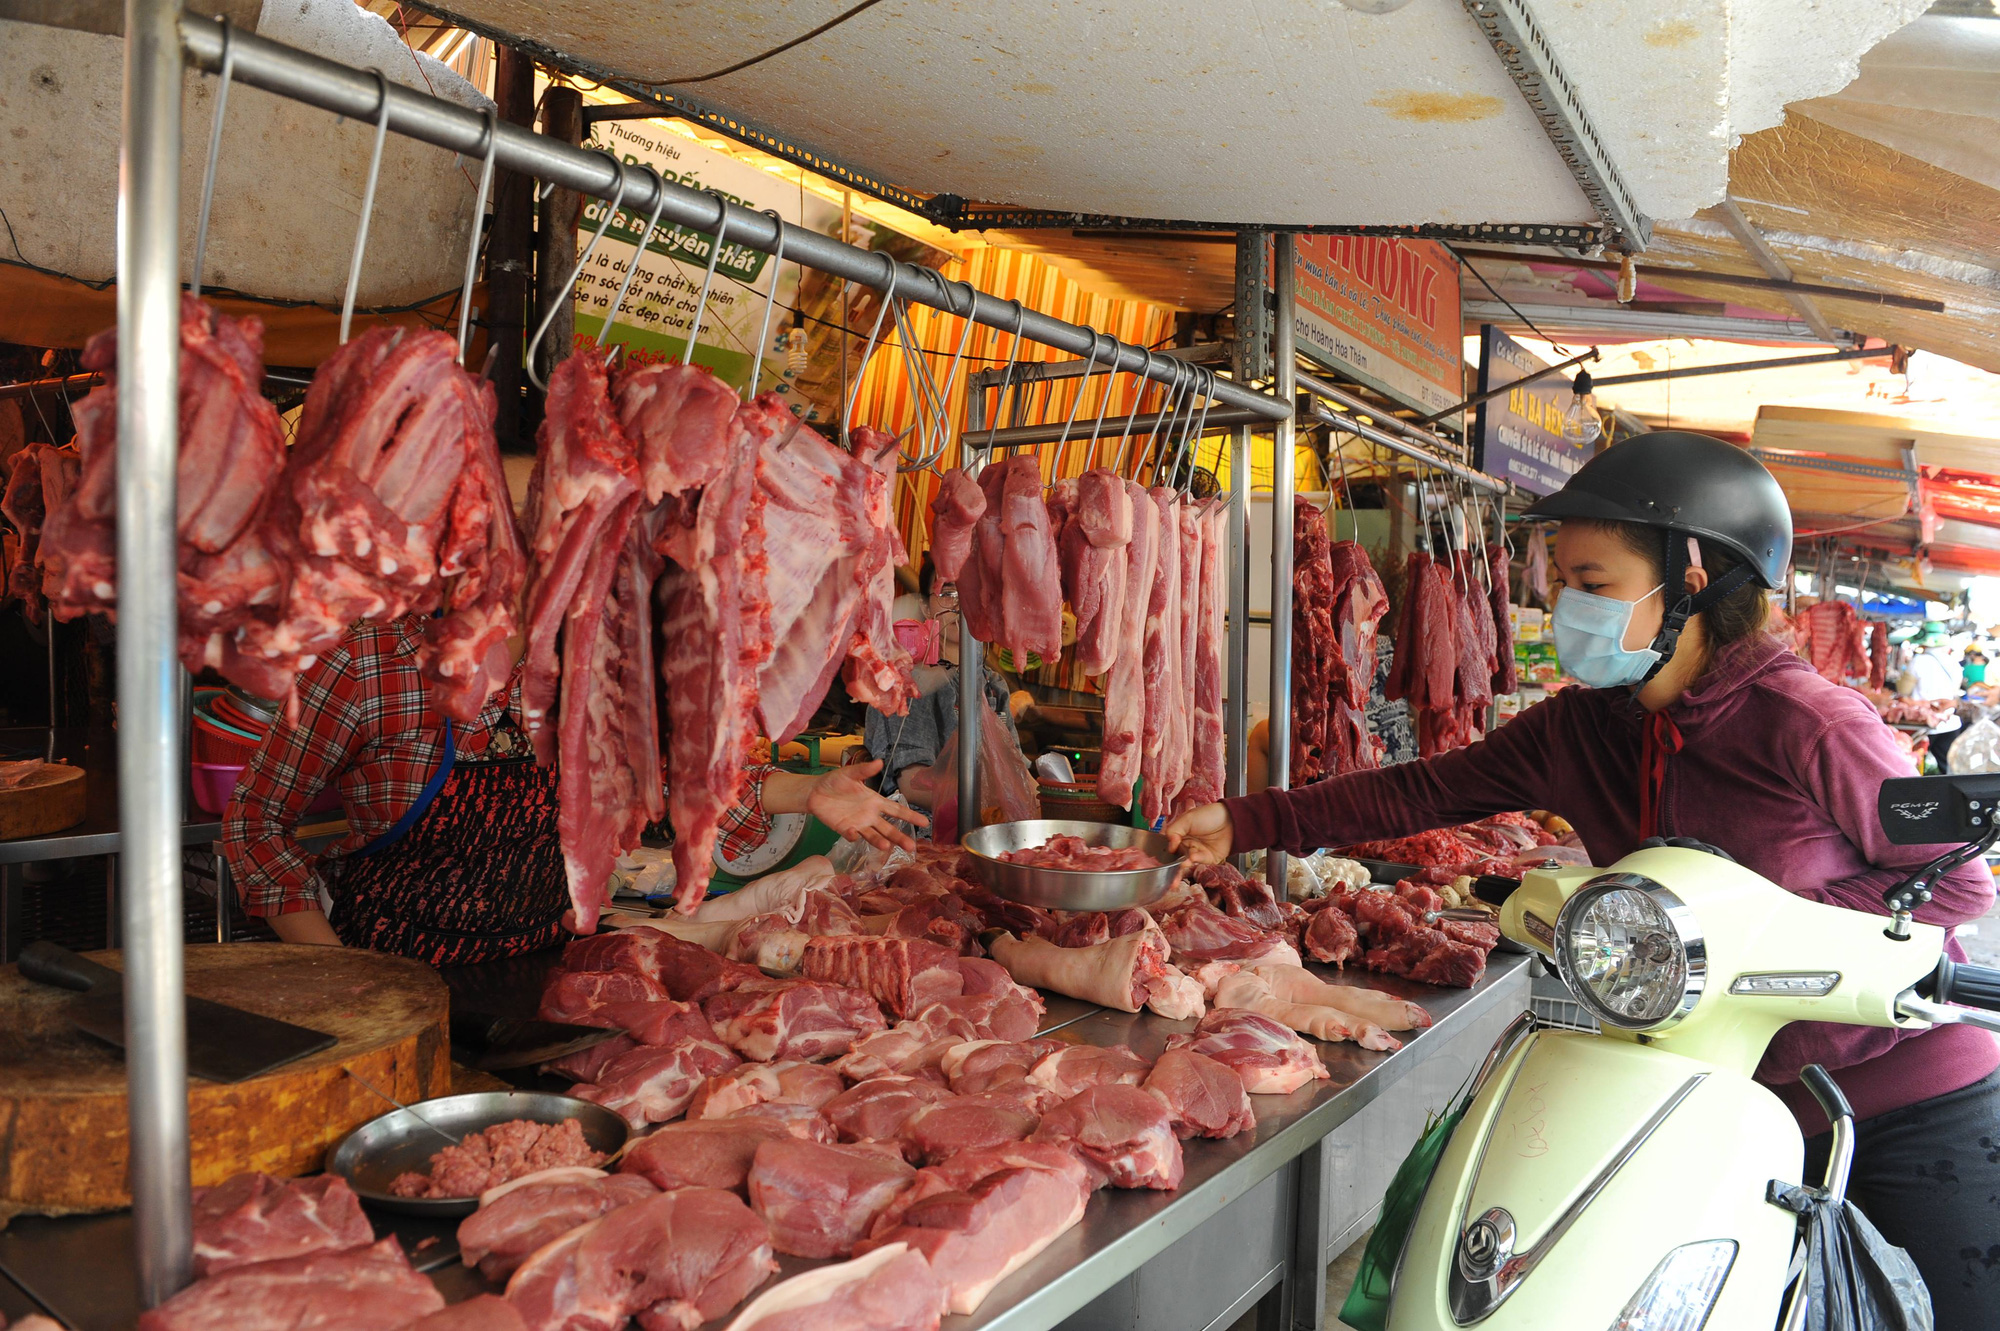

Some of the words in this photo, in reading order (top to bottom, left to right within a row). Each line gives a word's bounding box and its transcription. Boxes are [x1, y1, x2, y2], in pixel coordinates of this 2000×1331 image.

[610, 122, 654, 152] Thương
[655, 141, 681, 160] hiệu
[596, 253, 609, 268] là
[657, 273, 685, 291] chất
[1305, 260, 1322, 281] mua
[1324, 264, 1339, 292] bán
[593, 294, 608, 307] và
[636, 306, 660, 323] đẹp
[662, 313, 684, 328] của
[599, 276, 621, 291] sóc
[644, 289, 675, 307] nhất
[676, 299, 698, 313] cho
[1295, 317, 1310, 341] chợ
[1311, 323, 1333, 355] Hoàng
[1335, 338, 1348, 359] Hoa
[1349, 345, 1367, 369] Thám
[1528, 392, 1542, 427] BA
